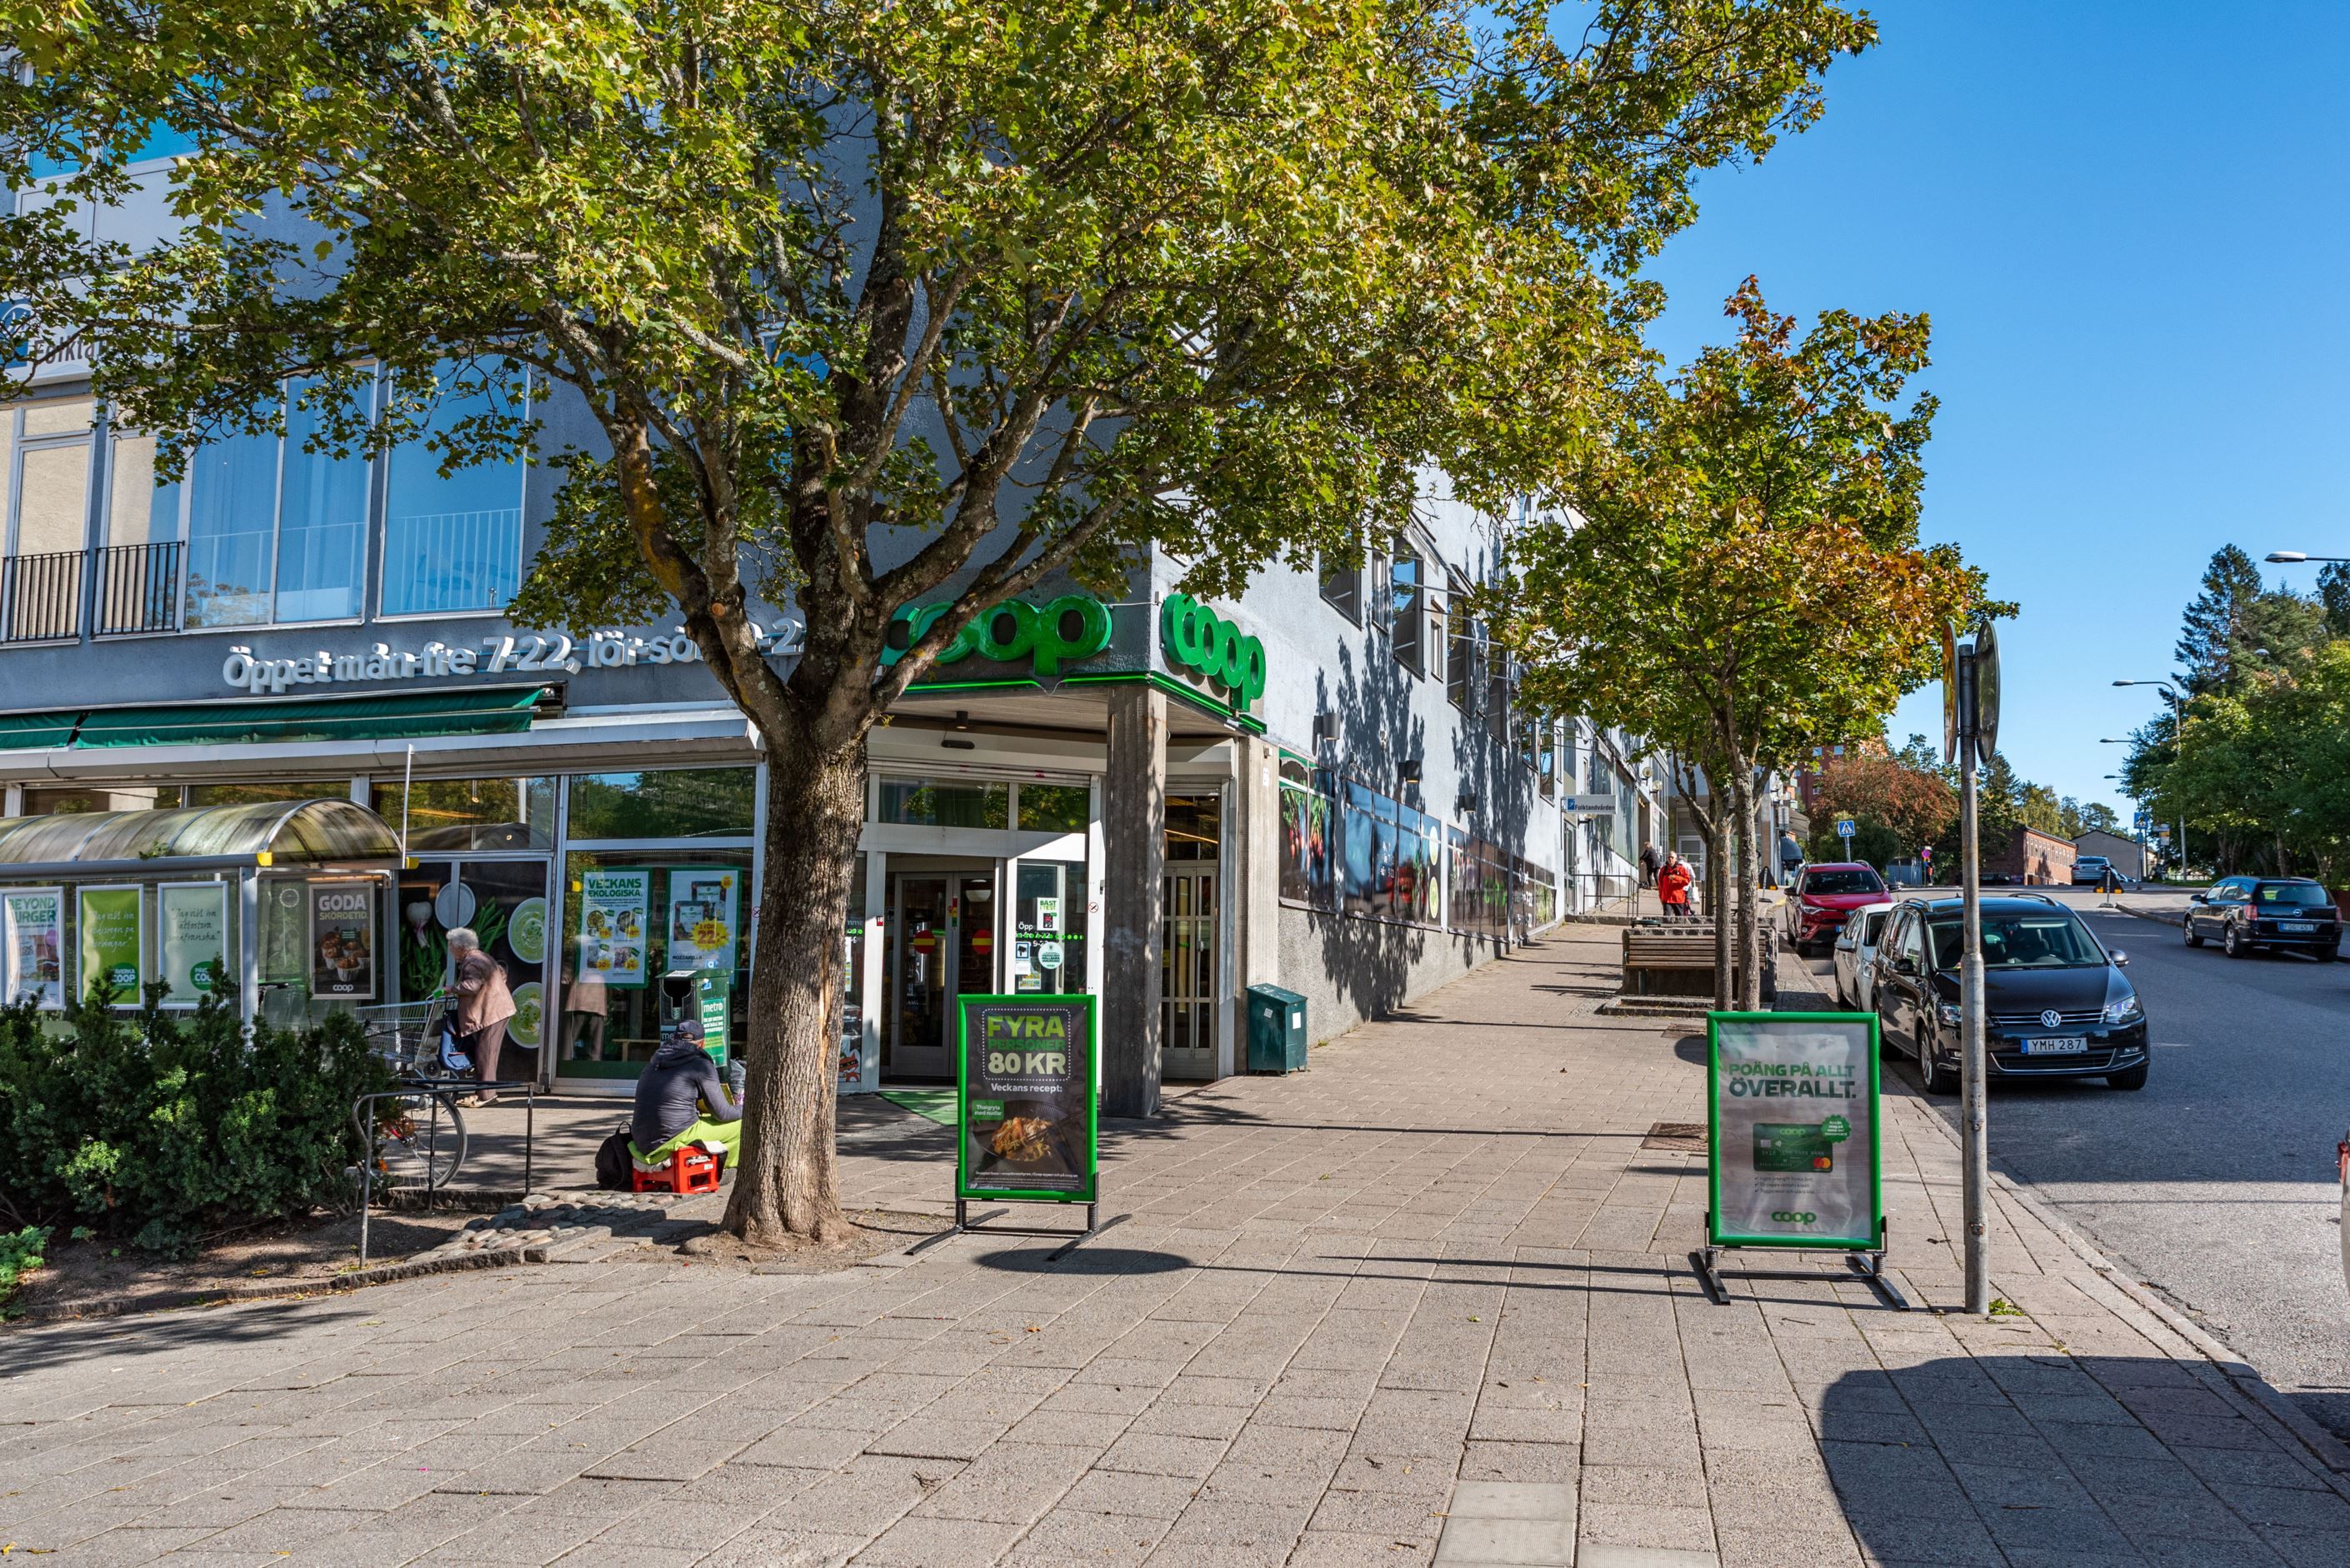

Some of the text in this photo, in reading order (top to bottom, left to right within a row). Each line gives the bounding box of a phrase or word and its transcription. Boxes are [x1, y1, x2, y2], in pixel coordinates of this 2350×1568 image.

[222, 645, 332, 694] Öppet
[335, 642, 478, 682] mån-fre
[588, 625, 707, 667] lör-sö
[588, 878, 642, 889] VECKANS
[318, 894, 367, 911] GODA
[16, 910, 56, 923] URGER
[332, 984, 354, 992] coop
[702, 1002, 724, 1013] metro
[987, 1015, 1065, 1038] FYRA
[988, 1039, 1065, 1051] PERSONER
[2032, 1039, 2082, 1051] YMH 287
[988, 1052, 1067, 1075] 80 KR
[1728, 1061, 1855, 1077] POÄNG PÅ ALLT
[991, 1083, 1062, 1094] Veckans recept:
[1728, 1077, 1858, 1098] ÖVERALLT.
[1771, 1211, 1817, 1226] coop
